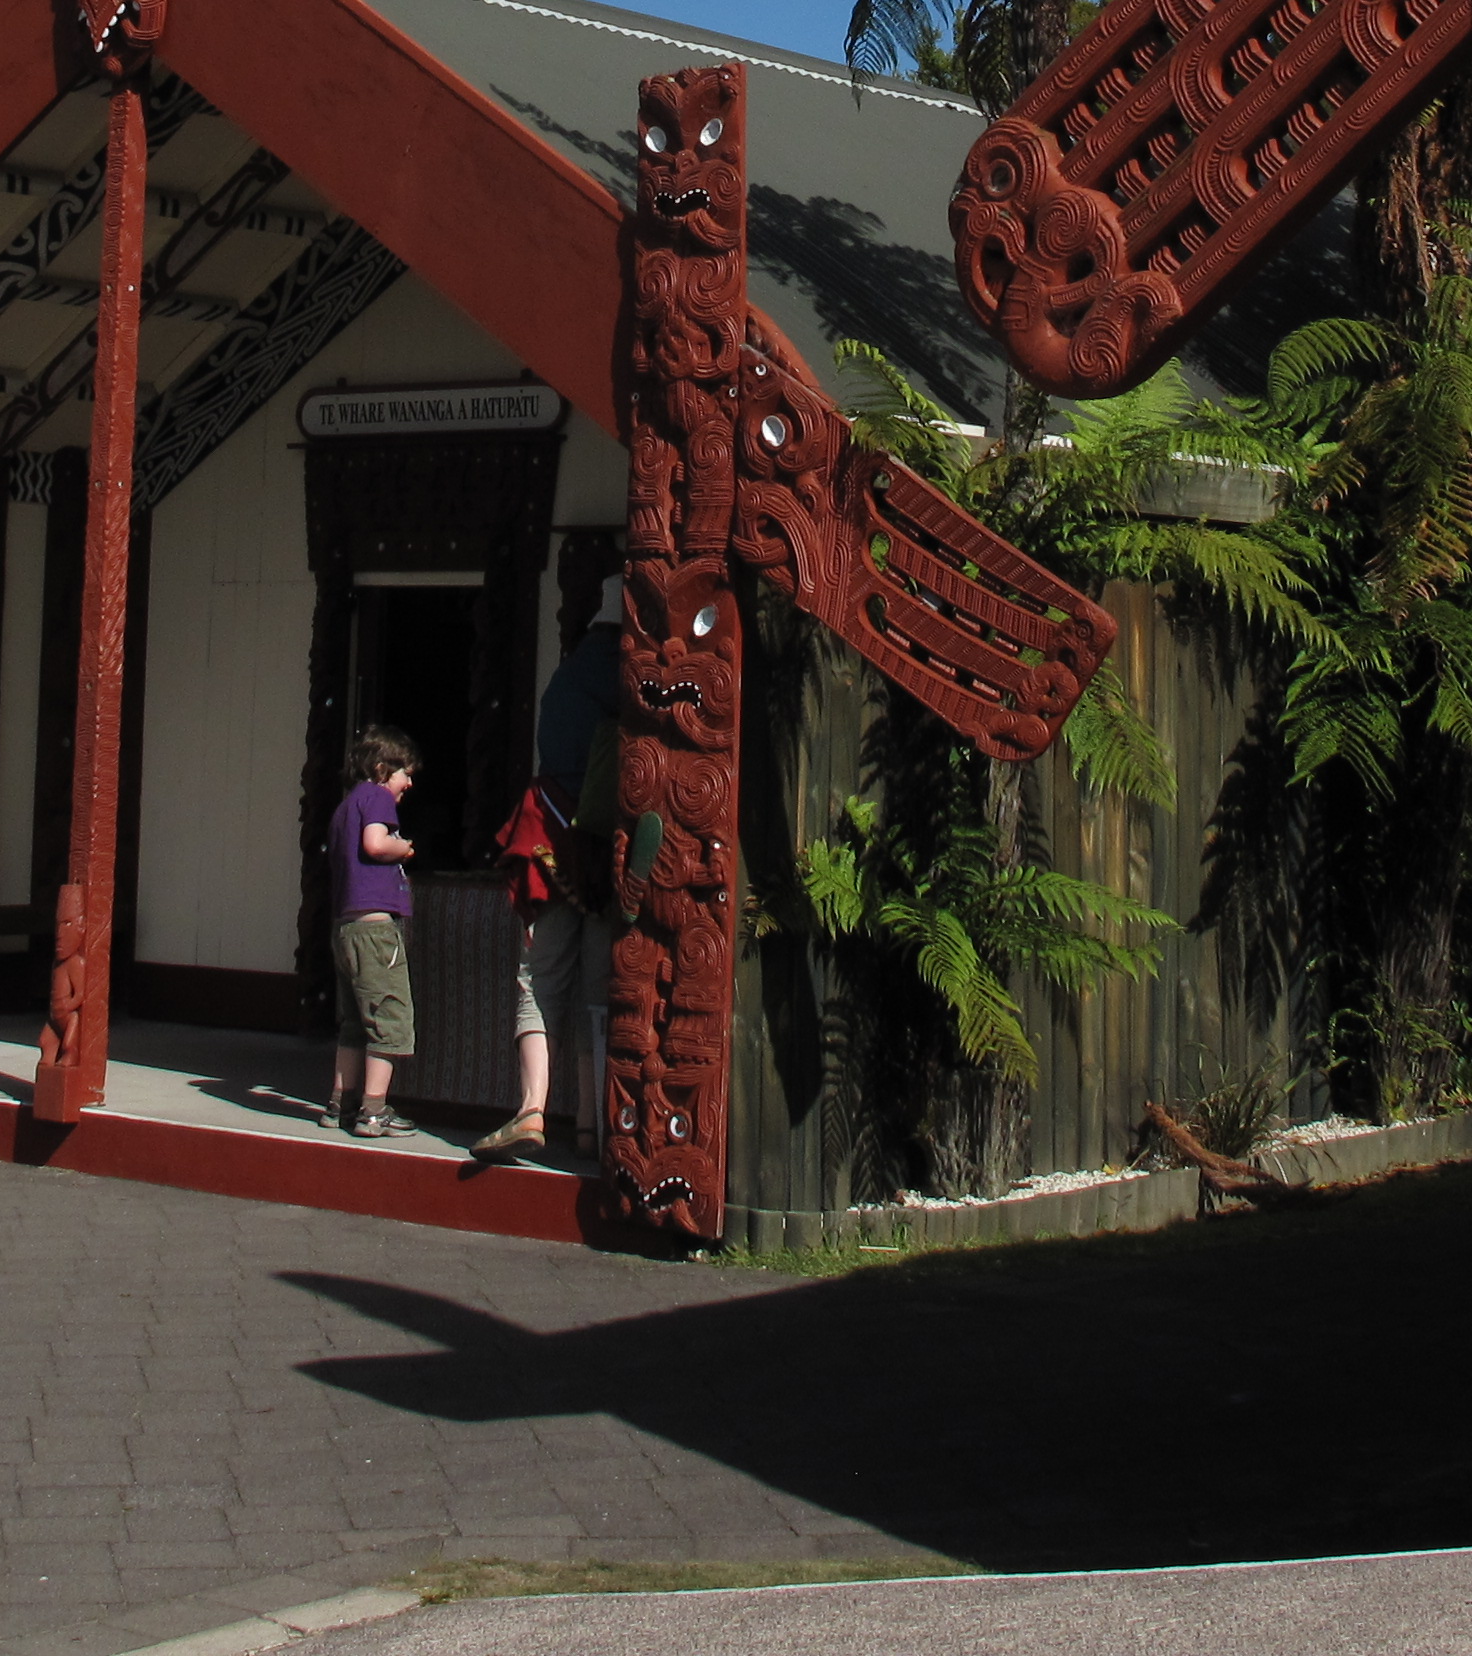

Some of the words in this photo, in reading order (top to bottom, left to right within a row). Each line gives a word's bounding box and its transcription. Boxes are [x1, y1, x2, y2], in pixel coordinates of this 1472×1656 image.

[320, 404, 335, 424] TE
[338, 402, 385, 423] WHARE
[388, 399, 454, 422] WANANGA
[458, 398, 467, 420] A
[471, 395, 540, 419] HATUPATU
